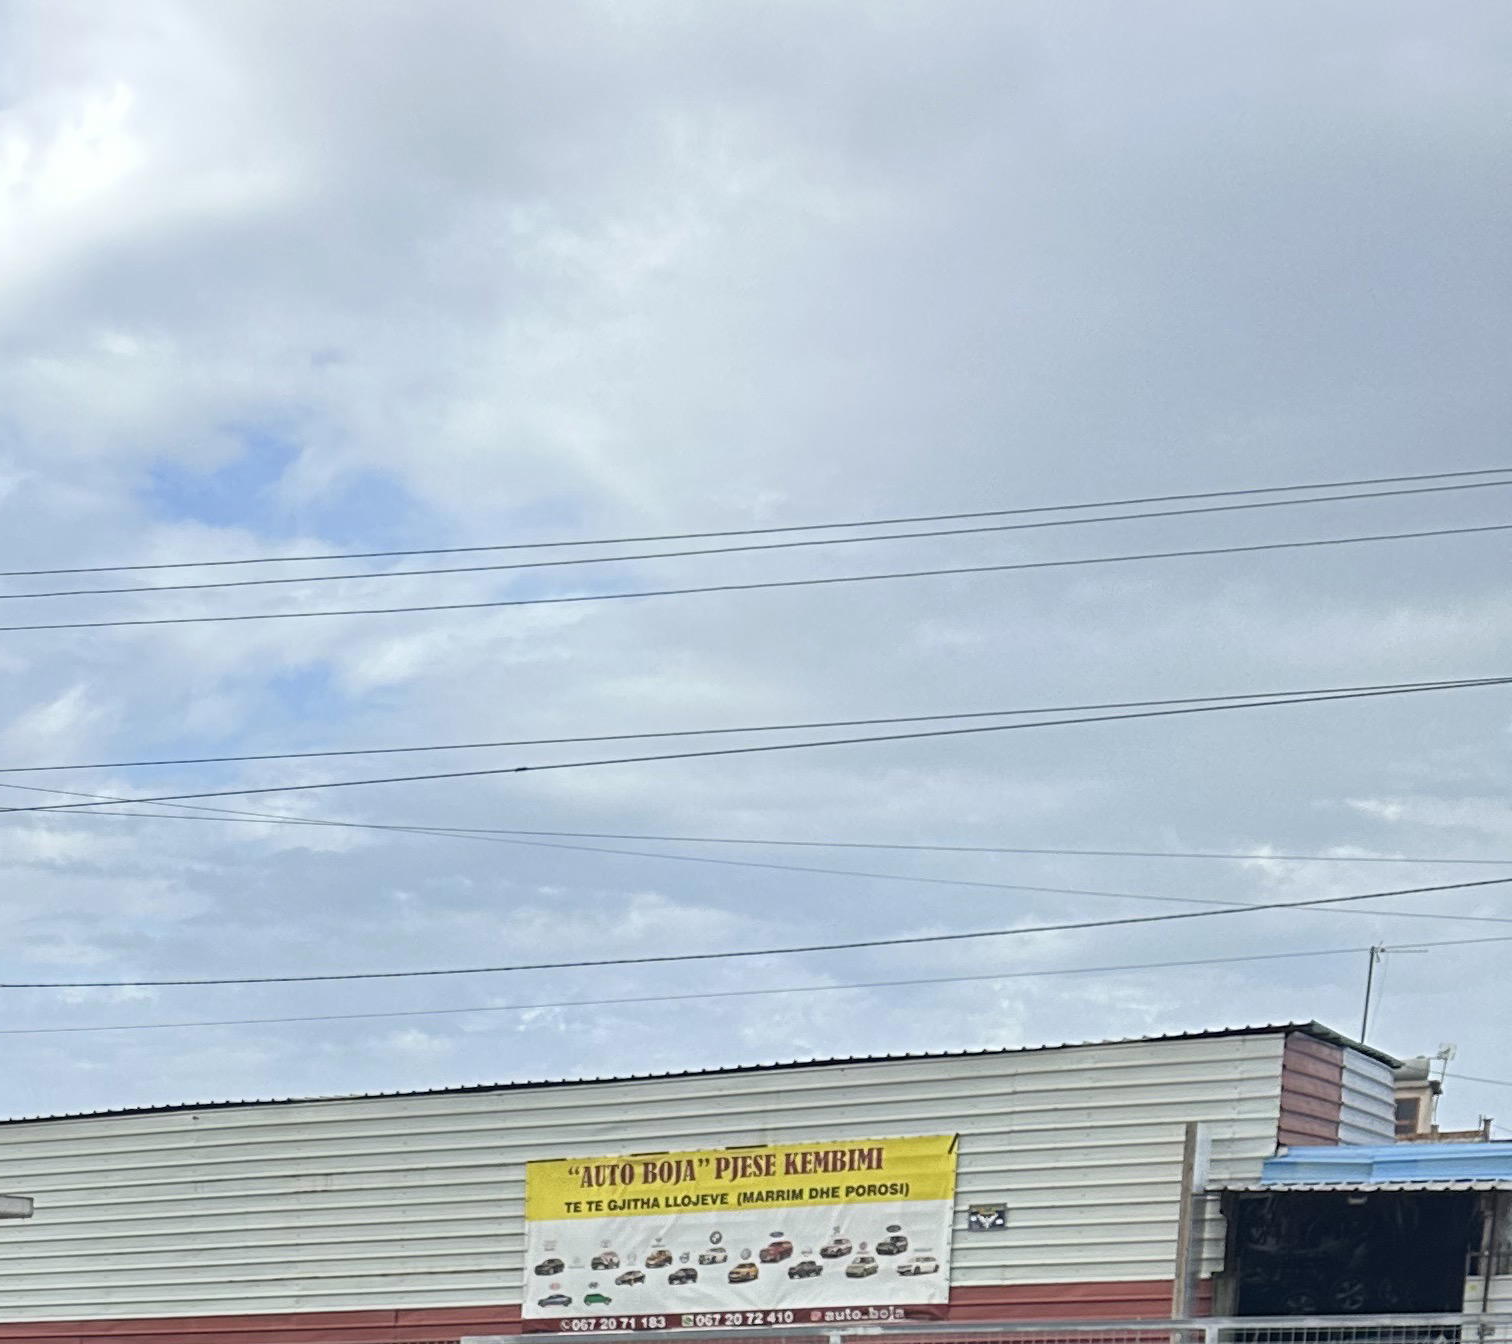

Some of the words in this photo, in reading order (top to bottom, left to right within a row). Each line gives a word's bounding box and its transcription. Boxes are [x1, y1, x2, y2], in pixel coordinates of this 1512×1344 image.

[568, 1163, 635, 1188] “AUTO
[642, 1158, 709, 1185] BOJA”
[714, 1154, 776, 1182] PJESE
[784, 1147, 884, 1175] KEMBIMI
[565, 1201, 582, 1213] TE
[586, 1200, 604, 1212] TE
[608, 1197, 660, 1211] GJITHA
[665, 1193, 729, 1208] LLOJEVE
[738, 1188, 803, 1206] (MARRIM
[809, 1186, 840, 1200] DHE
[845, 1183, 910, 1198] POROSI)
[571, 1319, 596, 1331] 067
[599, 1318, 617, 1330] 20
[621, 1317, 636, 1329] 71
[641, 1316, 666, 1328] 183
[695, 1313, 721, 1327] 067
[725, 1313, 742, 1325] 20
[746, 1312, 764, 1325] 72
[767, 1310, 794, 1323] 410
